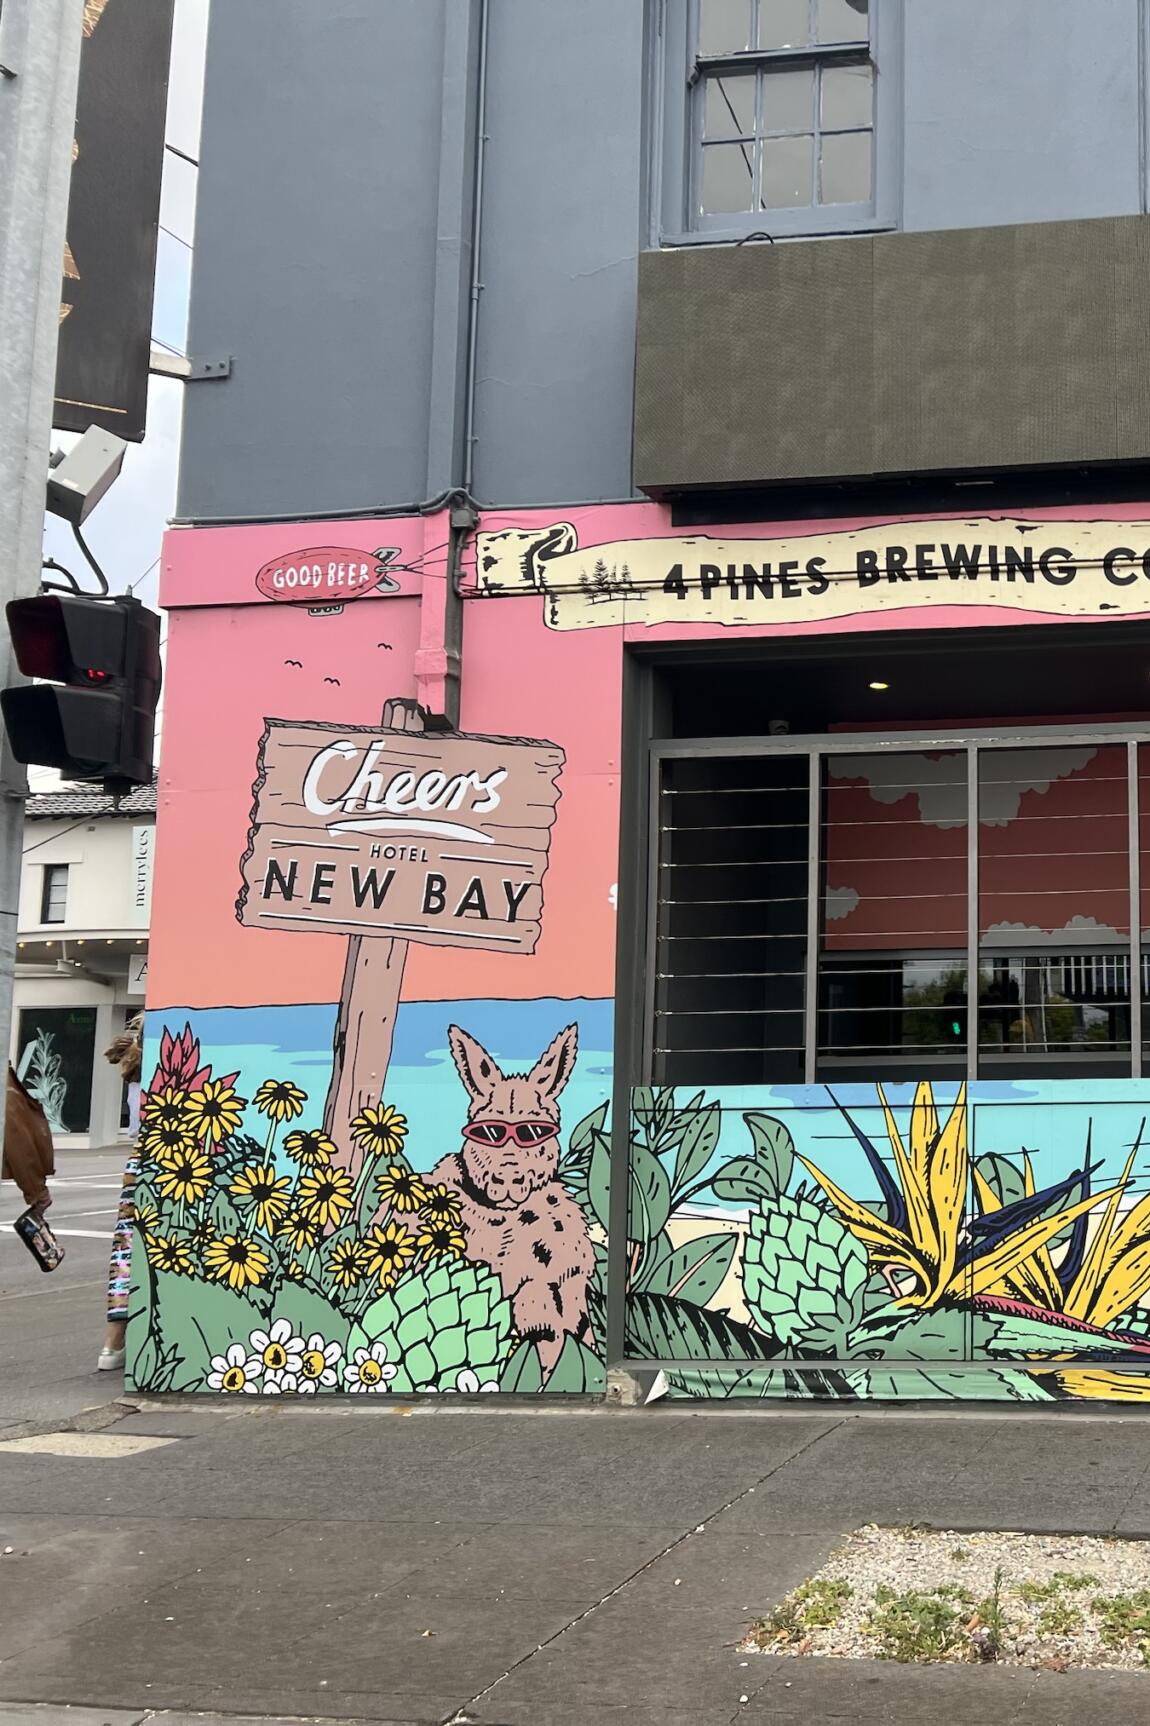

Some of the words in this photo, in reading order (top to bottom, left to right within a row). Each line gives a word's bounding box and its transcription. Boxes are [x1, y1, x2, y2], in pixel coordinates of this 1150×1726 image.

[272, 564, 323, 589] GOOD
[327, 561, 370, 587] BEER
[663, 563, 689, 600] 4
[699, 556, 831, 601] PINES
[856, 543, 1078, 588] BREWING
[302, 739, 509, 816] Cheers
[135, 830, 148, 907] merrylees
[370, 844, 429, 863] HOTEL
[261, 857, 397, 910] NEW
[421, 871, 533, 923] BAY
